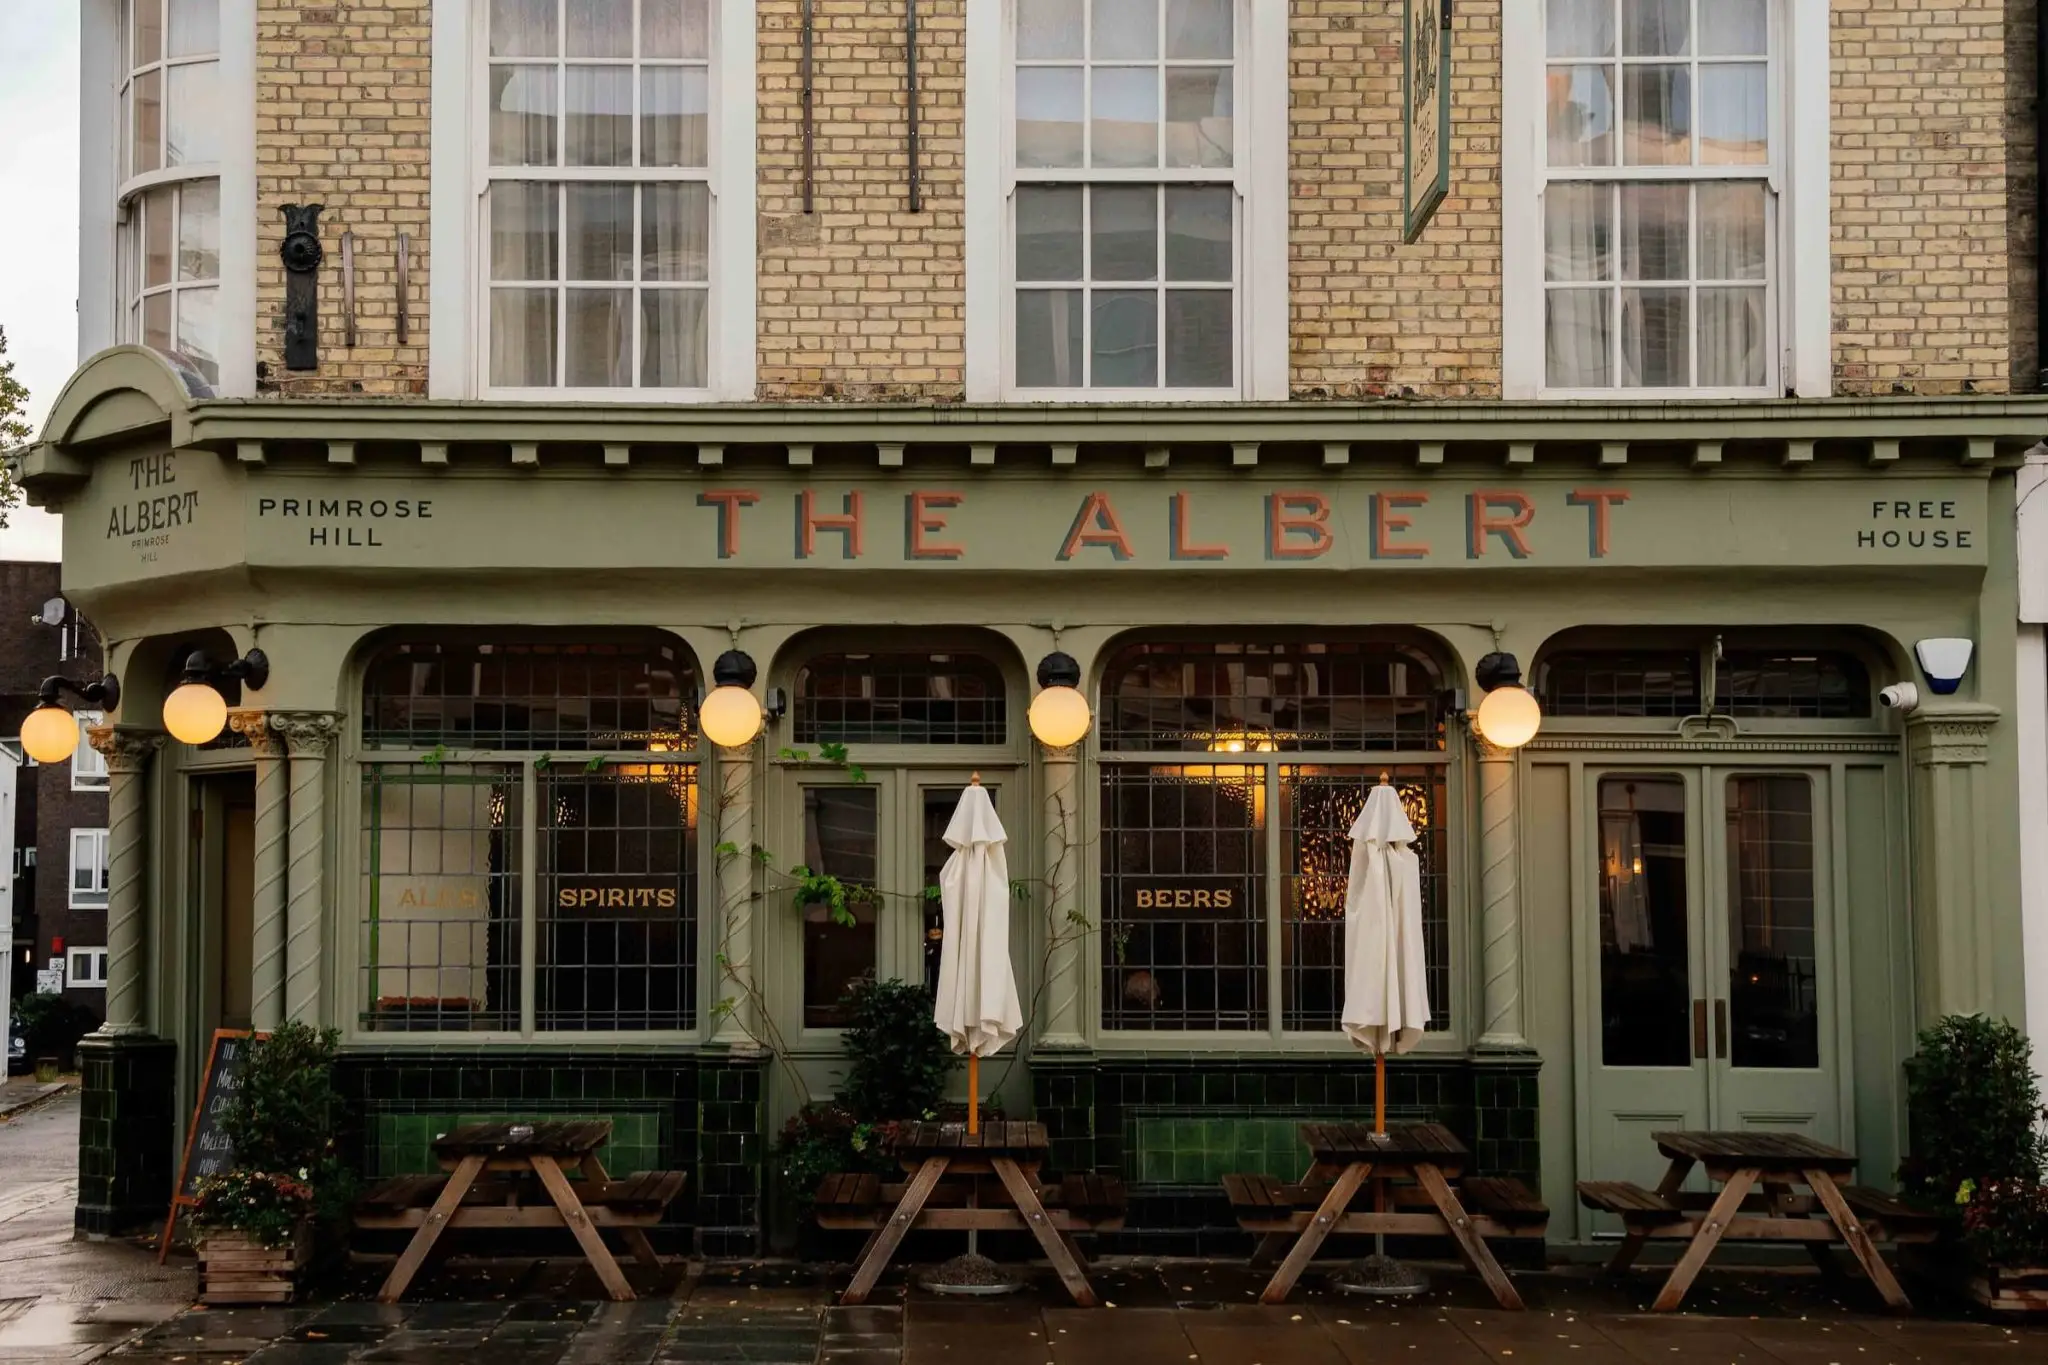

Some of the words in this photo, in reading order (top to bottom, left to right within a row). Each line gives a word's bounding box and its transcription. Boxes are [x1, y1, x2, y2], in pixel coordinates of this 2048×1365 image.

[1418, 110, 1431, 147] THE
[1412, 129, 1436, 185] ALBERT
[130, 451, 176, 490] THE
[106, 490, 199, 539] ALBERT
[259, 499, 433, 518] PRIMROSE
[1872, 501, 1956, 519] FREE
[696, 489, 965, 561] THE
[1054, 489, 1632, 562] ALBERT
[131, 534, 171, 550] PRIMROSE
[309, 527, 382, 547] HILL
[1857, 530, 1973, 548] HOUSE
[140, 552, 159, 563] HILL
[558, 887, 677, 908] SPIRITS
[1136, 889, 1232, 908] BEERS
